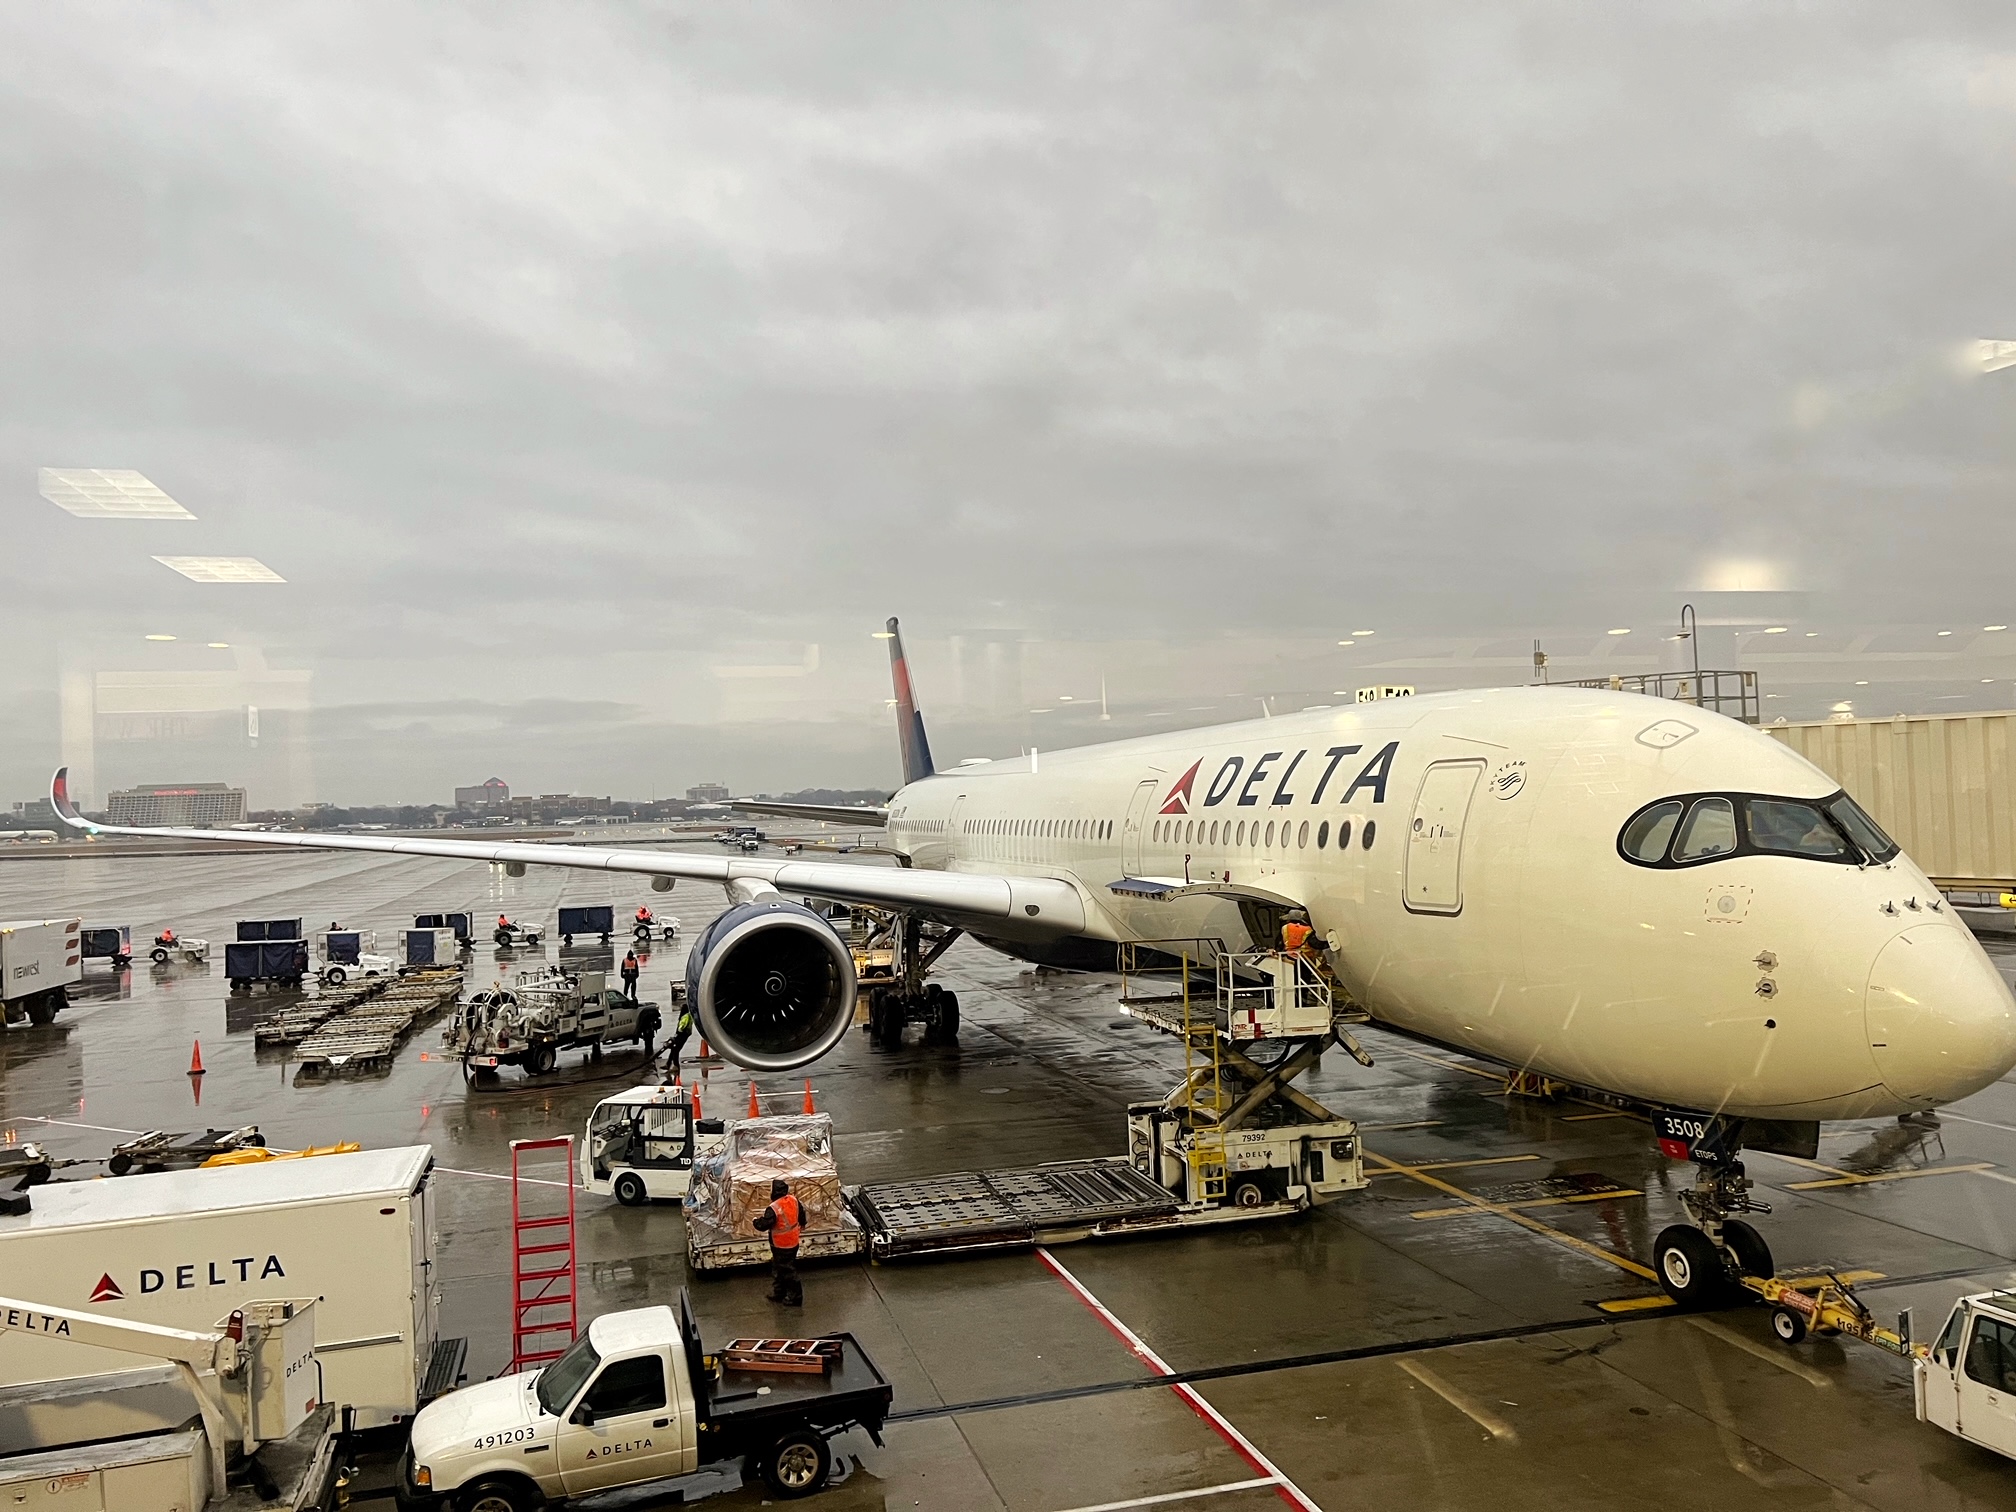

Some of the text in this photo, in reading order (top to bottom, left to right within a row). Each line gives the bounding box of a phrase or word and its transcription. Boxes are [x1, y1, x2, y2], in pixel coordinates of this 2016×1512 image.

[1203, 741, 1400, 807] DELTA
[1242, 1133, 1266, 1142] 79392
[1664, 1117, 1705, 1140] 3508
[1694, 1149, 1718, 1161] ETOPS
[140, 1254, 285, 1295] DELTA
[0, 1309, 70, 1336] ELTA
[286, 1350, 314, 1378] DELTA
[474, 1427, 535, 1450] 491203
[602, 1438, 653, 1457] DELTA
